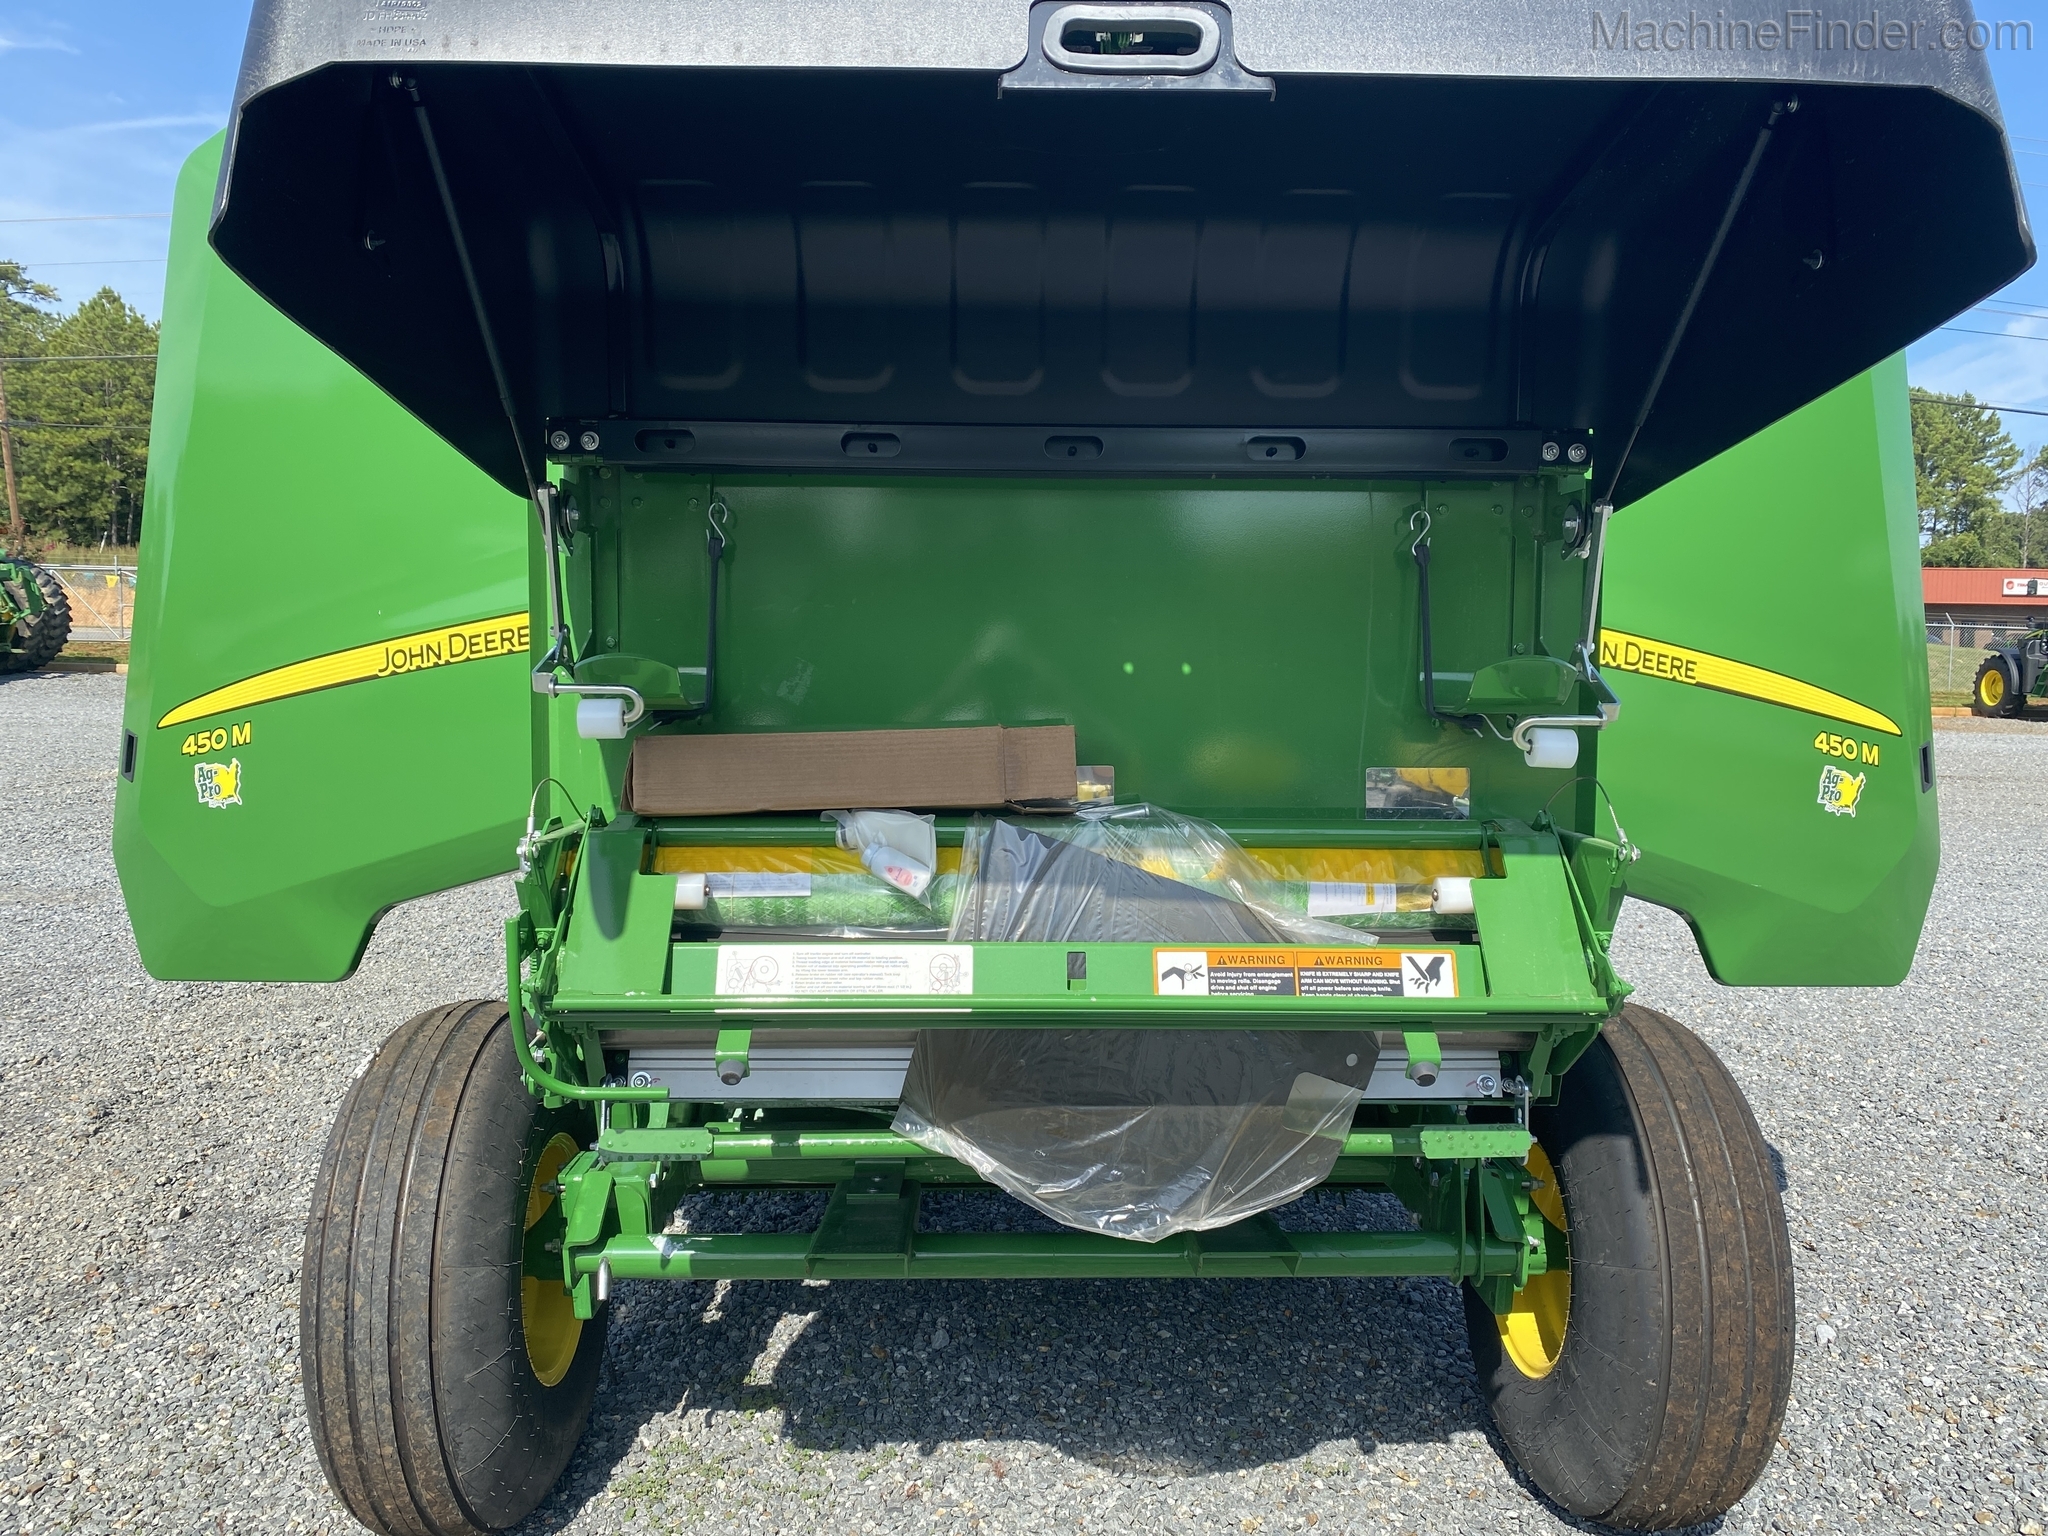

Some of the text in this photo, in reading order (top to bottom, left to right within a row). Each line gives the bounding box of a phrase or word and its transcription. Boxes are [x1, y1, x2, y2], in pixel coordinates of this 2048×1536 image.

[357, 39, 387, 47] MADE
[378, 625, 529, 673] JOHN DEERE
[1624, 641, 1697, 680] DEERE
[181, 720, 252, 757] 450 M
[1814, 730, 1880, 767] 450 M
[198, 766, 218, 785] Ag-
[1822, 769, 1844, 789] Ag-
[200, 783, 221, 800] Pro
[1820, 785, 1842, 801] Pro
[1227, 955, 1286, 965] WARNING
[1325, 956, 1383, 965] WARNING
